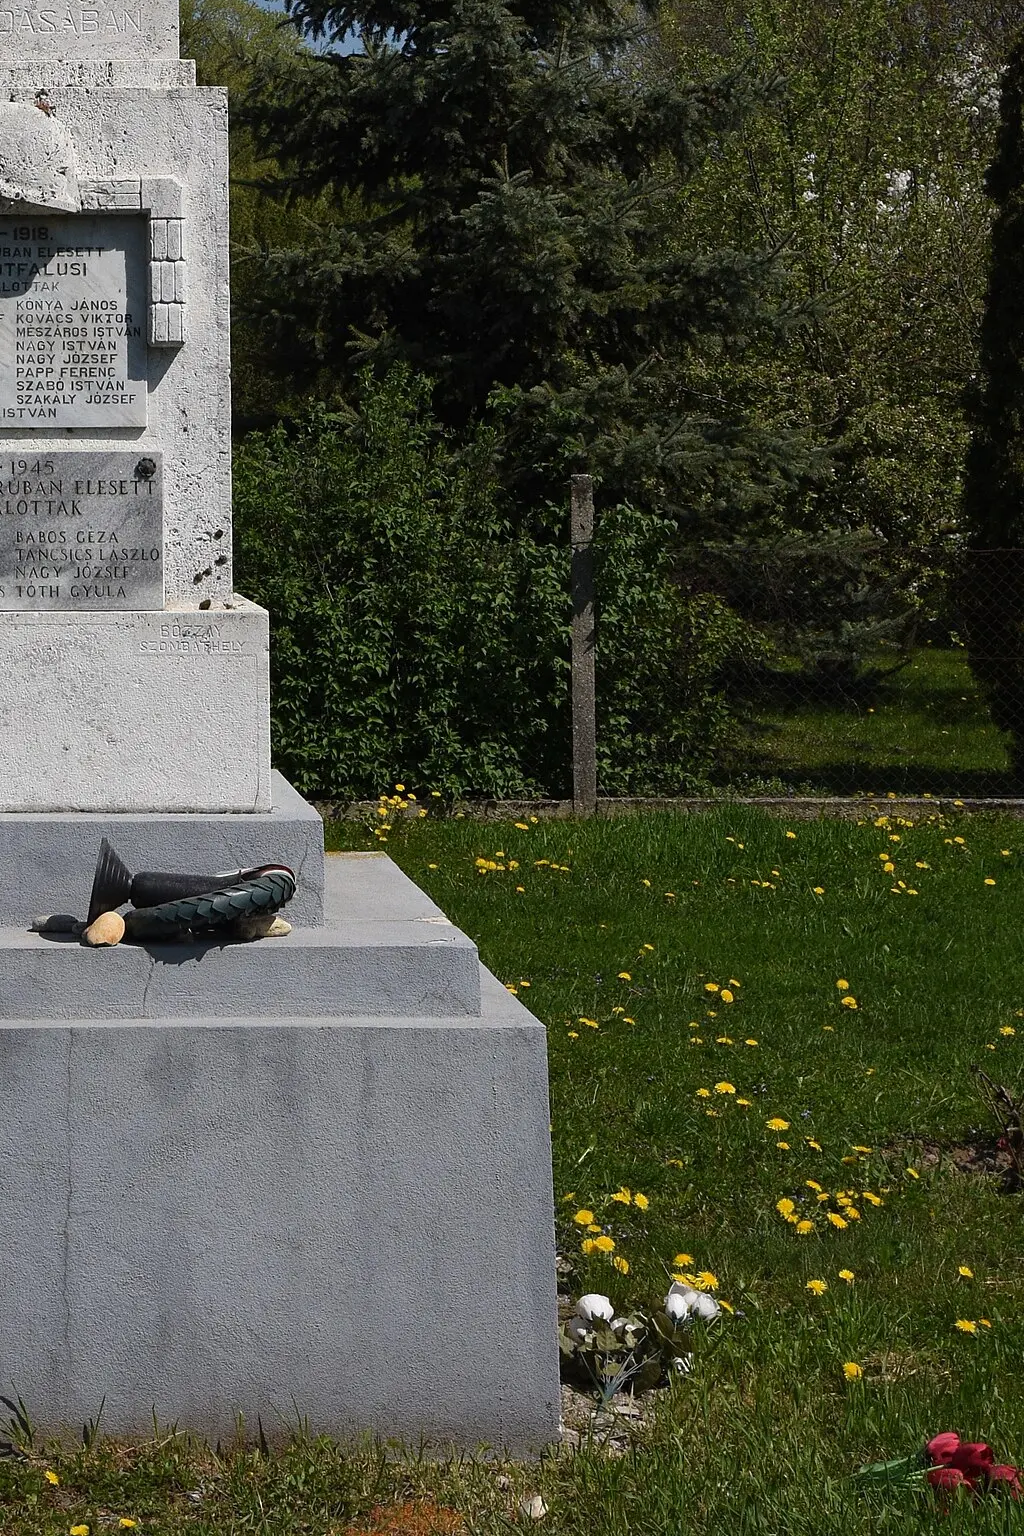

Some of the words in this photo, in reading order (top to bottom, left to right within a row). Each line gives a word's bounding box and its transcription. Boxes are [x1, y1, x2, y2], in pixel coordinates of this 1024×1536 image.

[13, 226, 54, 241] 1918.
[37, 247, 104, 258] ELESETT
[70, 297, 118, 310] JÁNOS
[16, 311, 73, 324] KOVÁCS
[80, 314, 133, 324] VIKTOR
[16, 324, 88, 337] MÉSZÁROS
[93, 324, 141, 337] ISTVÁN
[16, 341, 55, 351] NAGY
[62, 338, 117, 351] ISTVÁN
[16, 354, 55, 364] NAGY
[63, 351, 118, 364] JÓZSEF
[16, 368, 54, 377] PAPP
[60, 368, 116, 377] FERENC
[16, 378, 65, 391] SZABÓ
[71, 378, 125, 391] ISTVÁN
[16, 392, 76, 405] SZAKÁLY
[85, 392, 137, 405] JÓZSEF
[2, 405, 57, 418] ISTVÁN
[11, 460, 55, 475] 1945
[75, 480, 156, 495] ELESETT
[16, 531, 66, 543] BABOS
[76, 526, 118, 543] GÉZA
[99, 545, 160, 561] LÁSZLÓ
[15, 567, 62, 578] NAGY
[74, 562, 129, 578] JÓZSEF
[16, 581, 59, 597] TÓTH
[71, 585, 127, 597] GYULA
